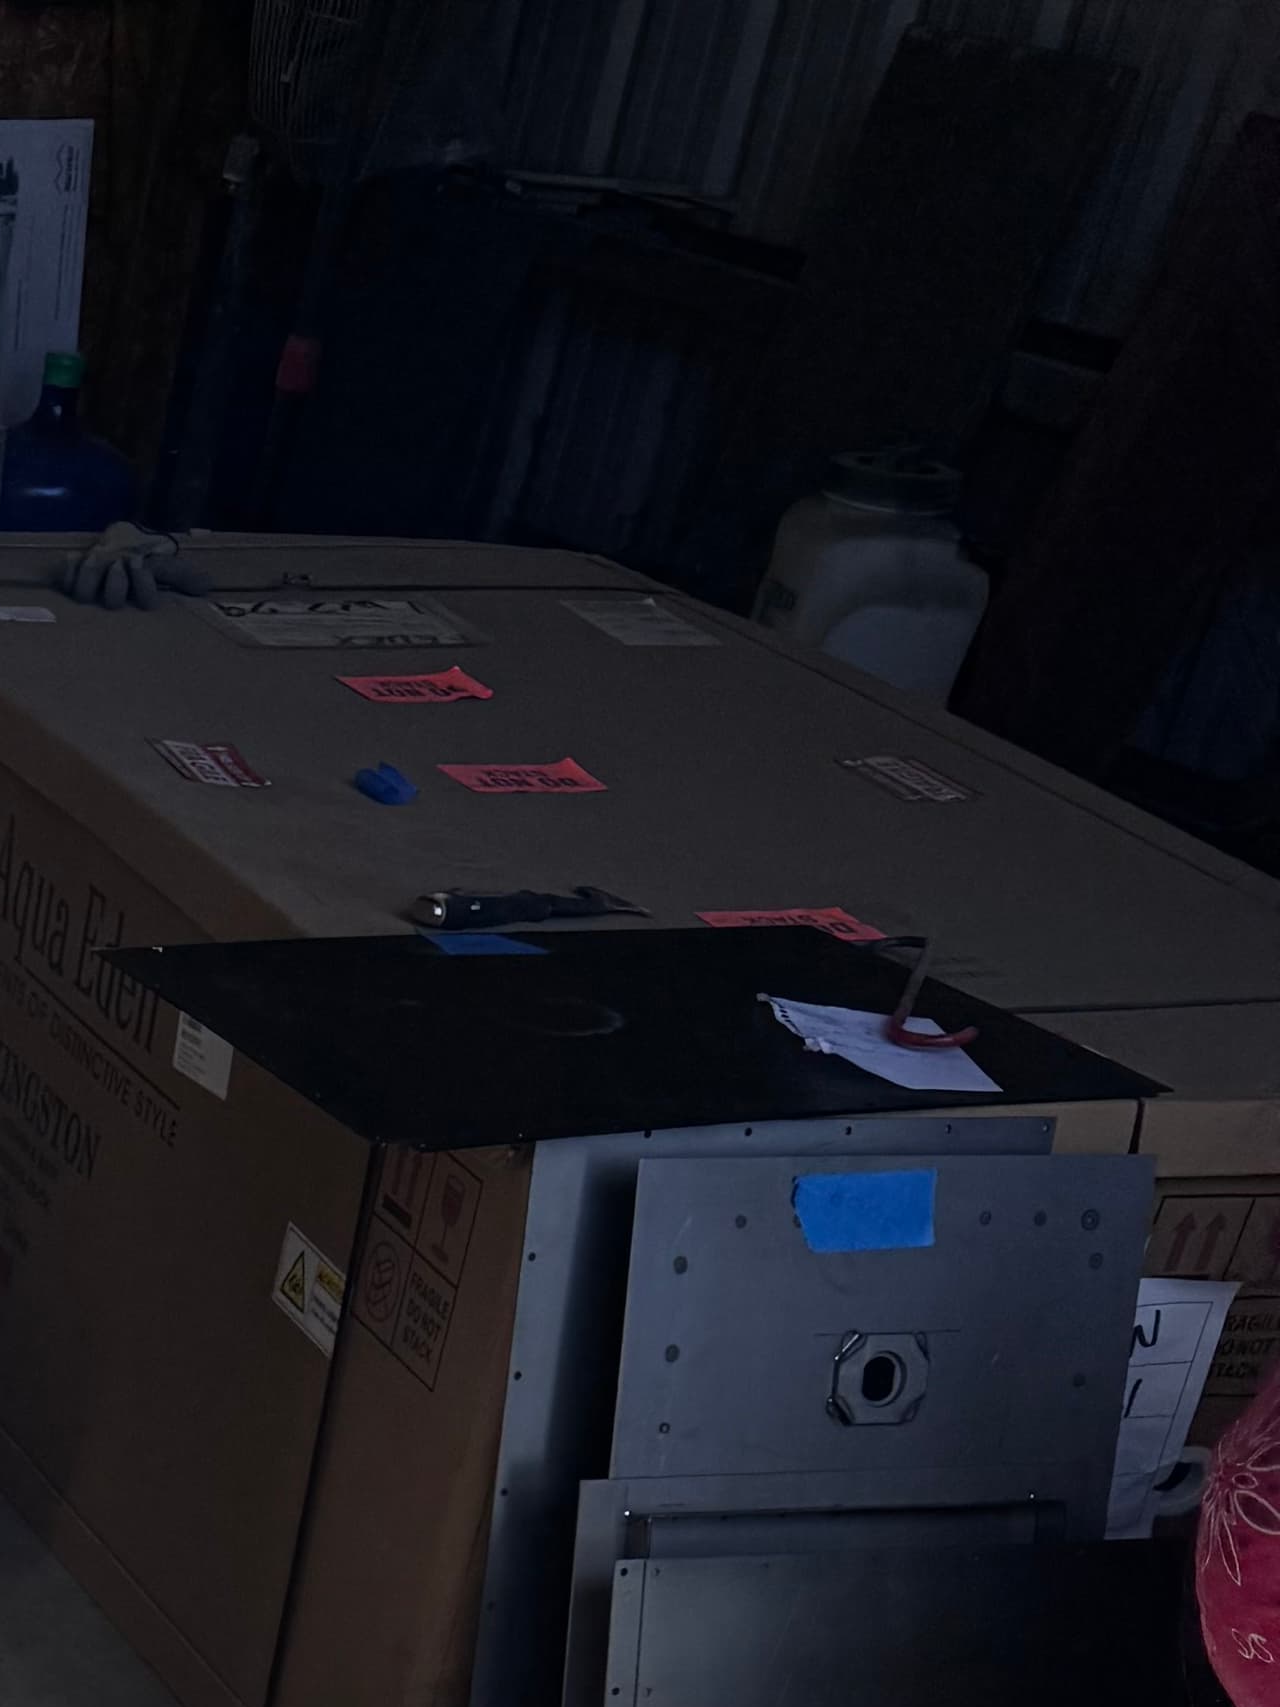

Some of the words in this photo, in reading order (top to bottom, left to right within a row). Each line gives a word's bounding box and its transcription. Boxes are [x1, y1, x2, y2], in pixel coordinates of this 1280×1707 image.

[478, 778, 533, 787] NOT
[49, 1014, 132, 1106] DISTINCTIVE
[133, 1089, 179, 1148] STYLE
[412, 1272, 451, 1320] FRAGILE
[401, 1327, 432, 1363] STACK
[1214, 1362, 1258, 1378] TACK
